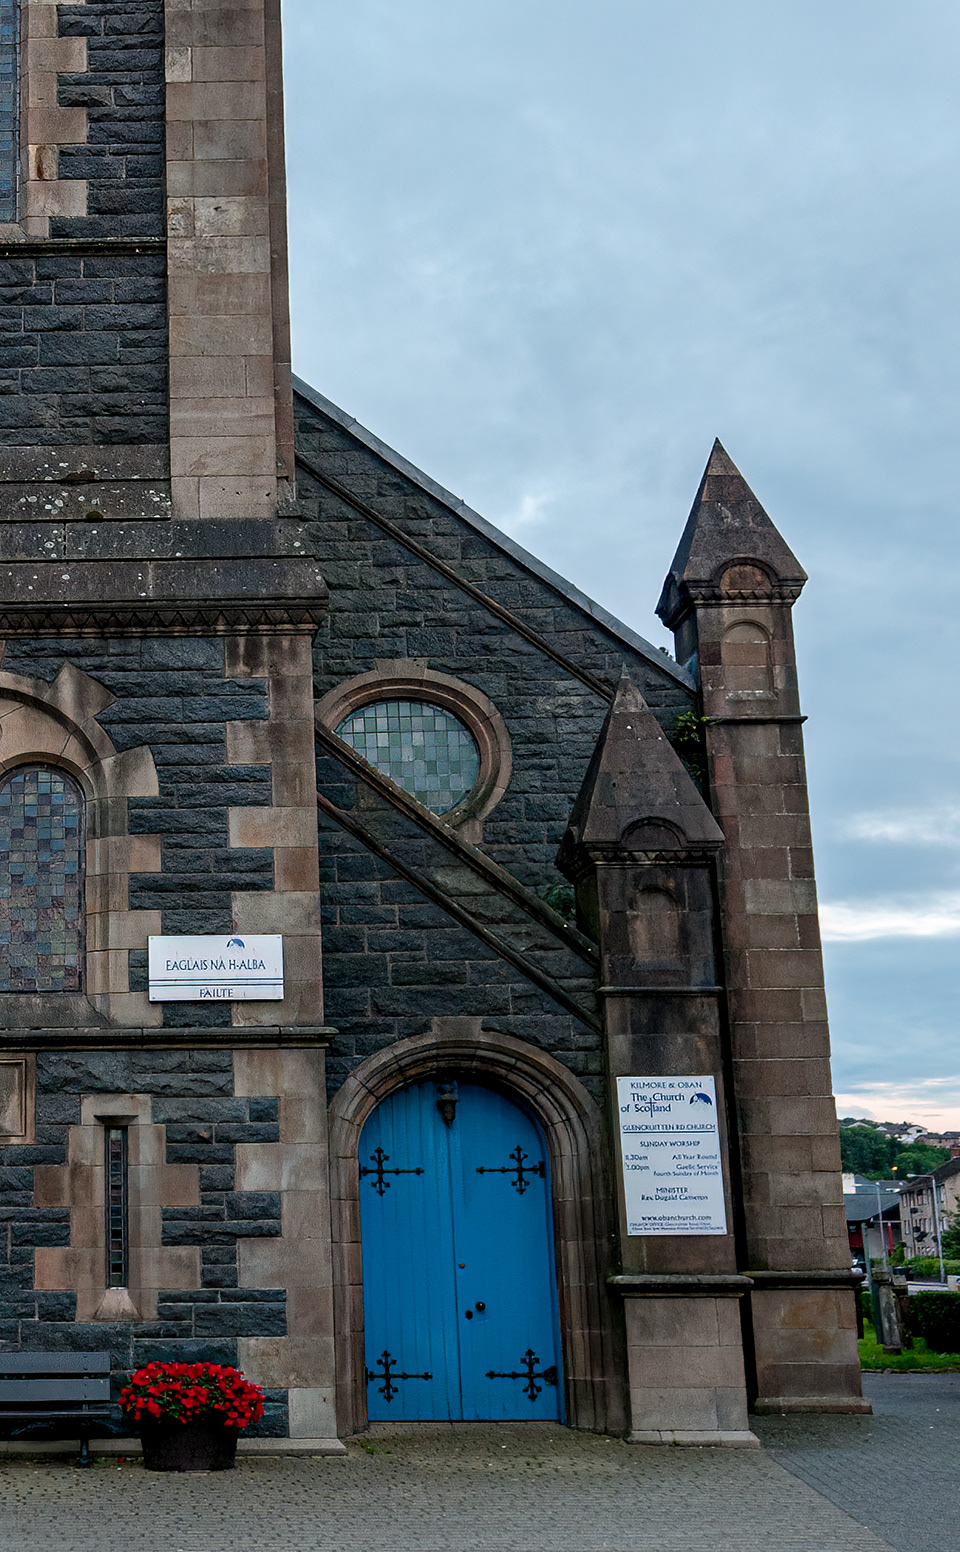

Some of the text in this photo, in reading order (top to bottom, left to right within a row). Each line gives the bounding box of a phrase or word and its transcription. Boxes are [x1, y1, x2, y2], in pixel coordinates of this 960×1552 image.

[166, 959, 266, 971] EAGLAIS NA H-ALBA
[630, 1092, 684, 1102] The Church
[620, 1101, 672, 1114] of Scotland
